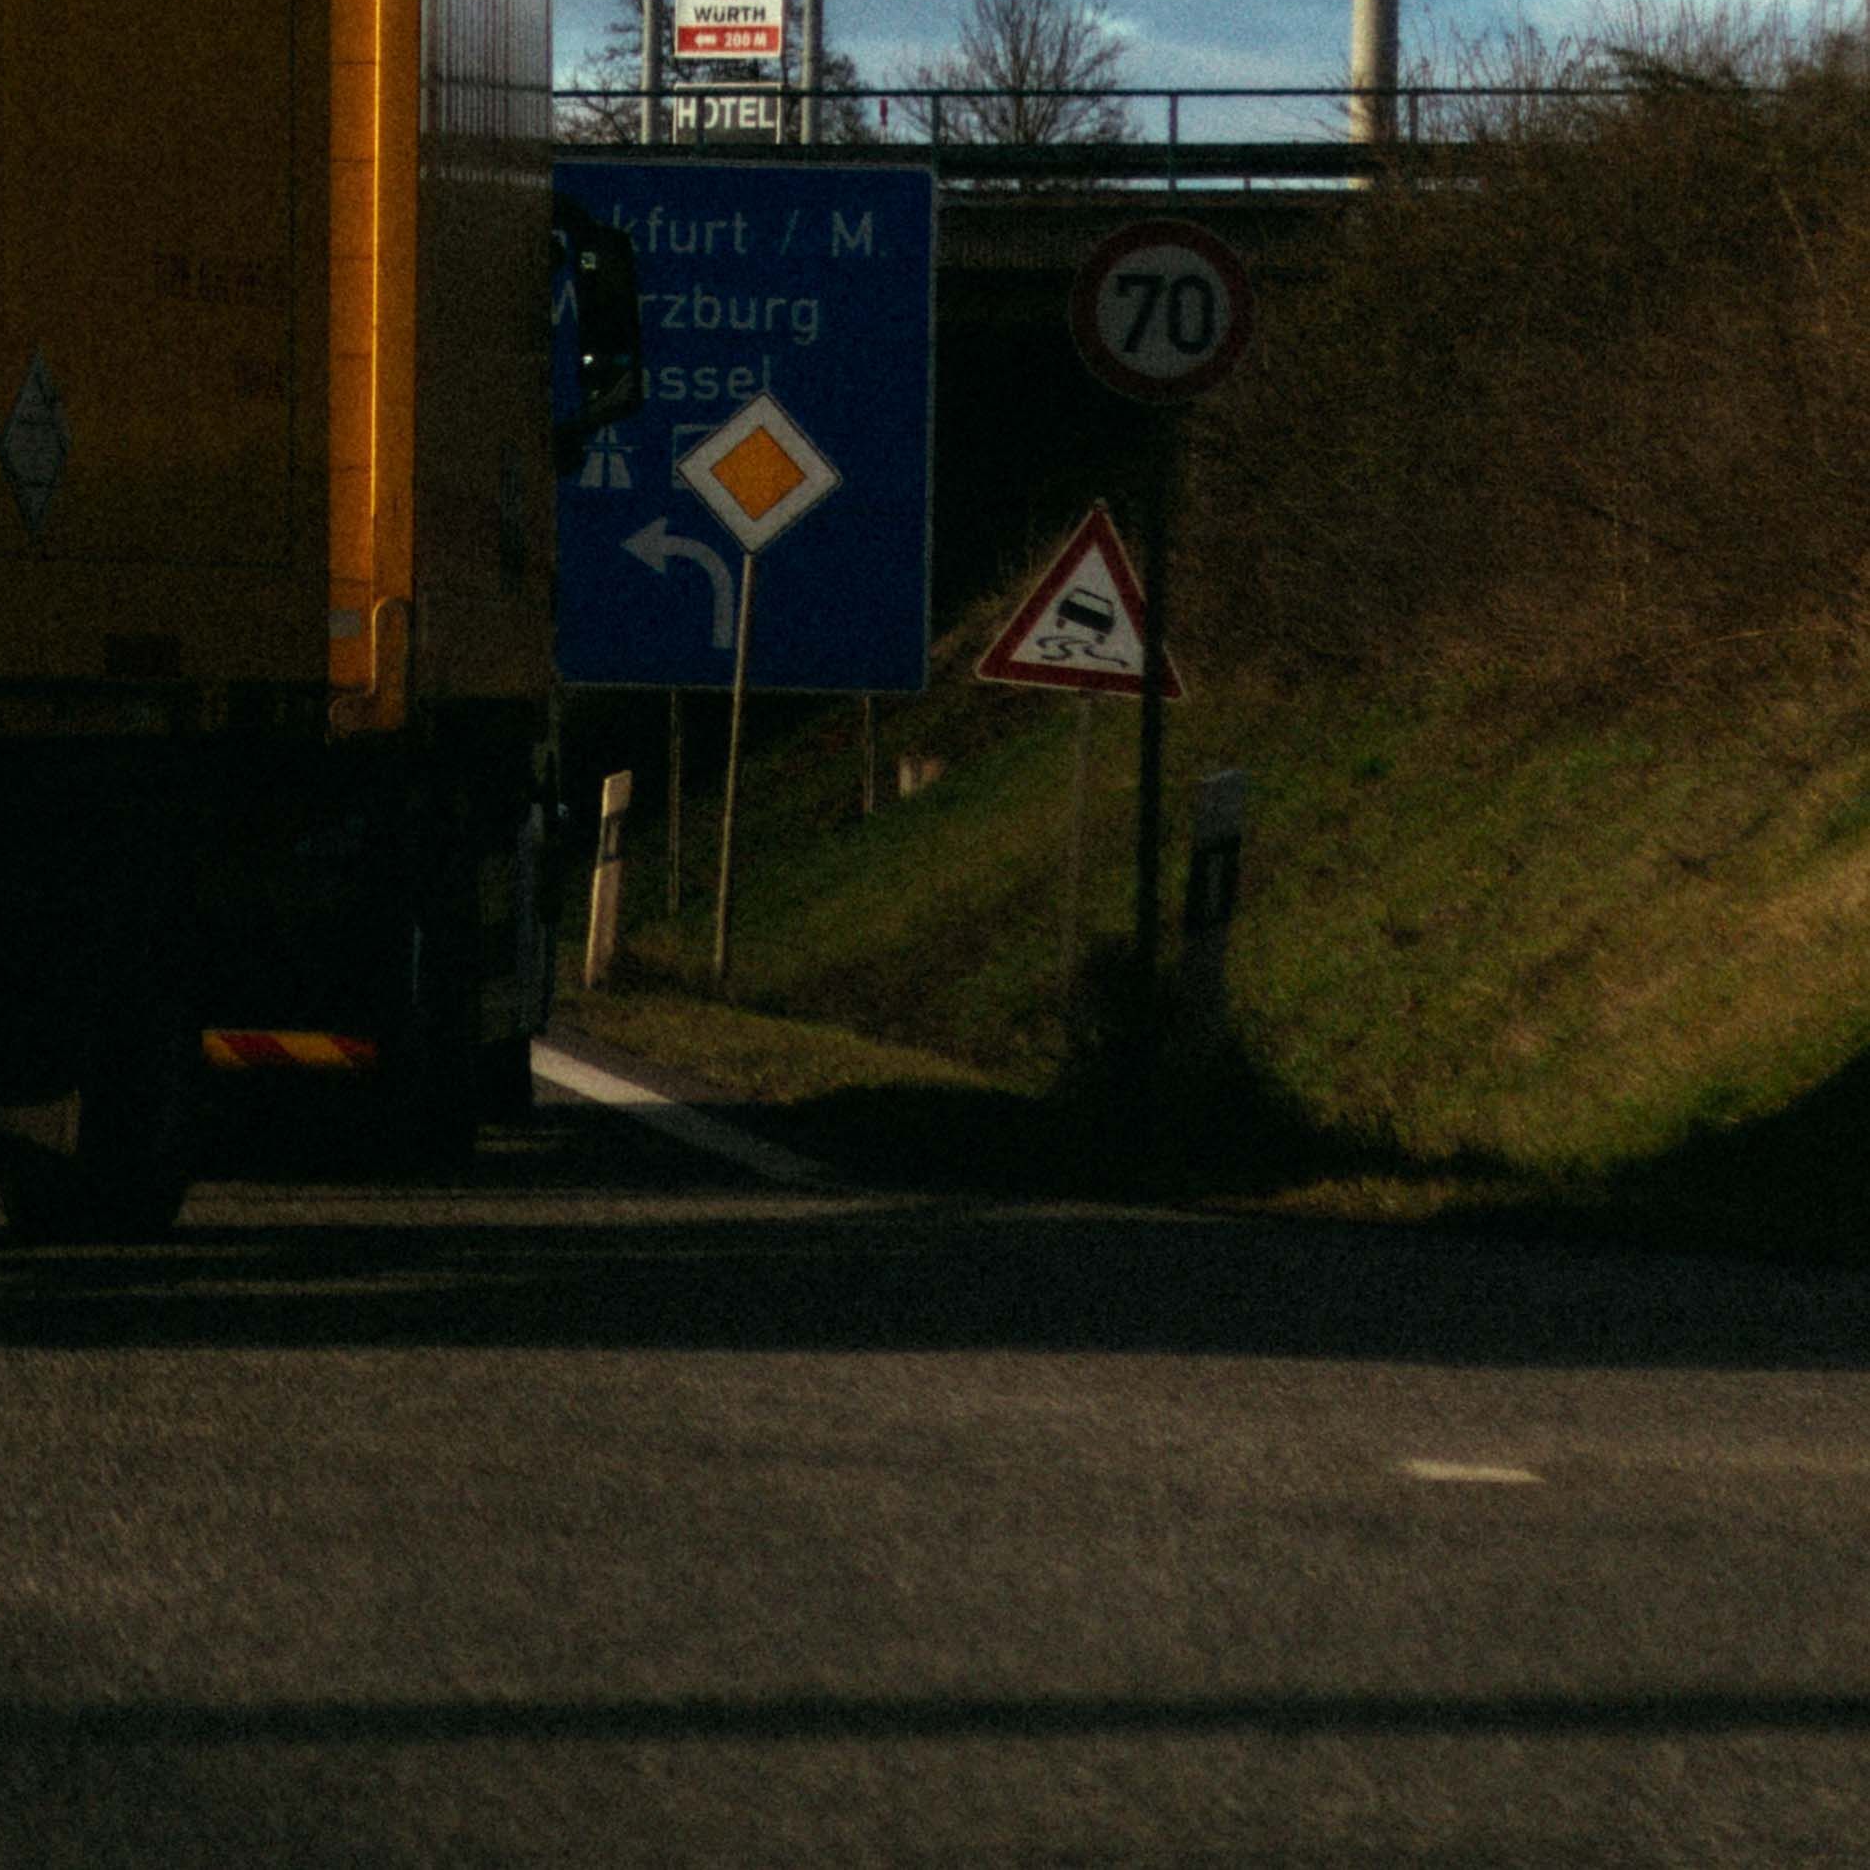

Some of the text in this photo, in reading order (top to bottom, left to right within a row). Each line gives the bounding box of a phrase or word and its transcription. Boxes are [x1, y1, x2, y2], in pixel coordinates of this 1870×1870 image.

[693, 6, 766, 23] WÜRTH
[753, 32, 767, 48] M
[678, 97, 775, 129] HOTEL
[551, 202, 749, 257] kfurt
[551, 279, 820, 347] Wrzburg
[1117, 274, 1215, 355] 70
[641, 352, 773, 401] ssel
